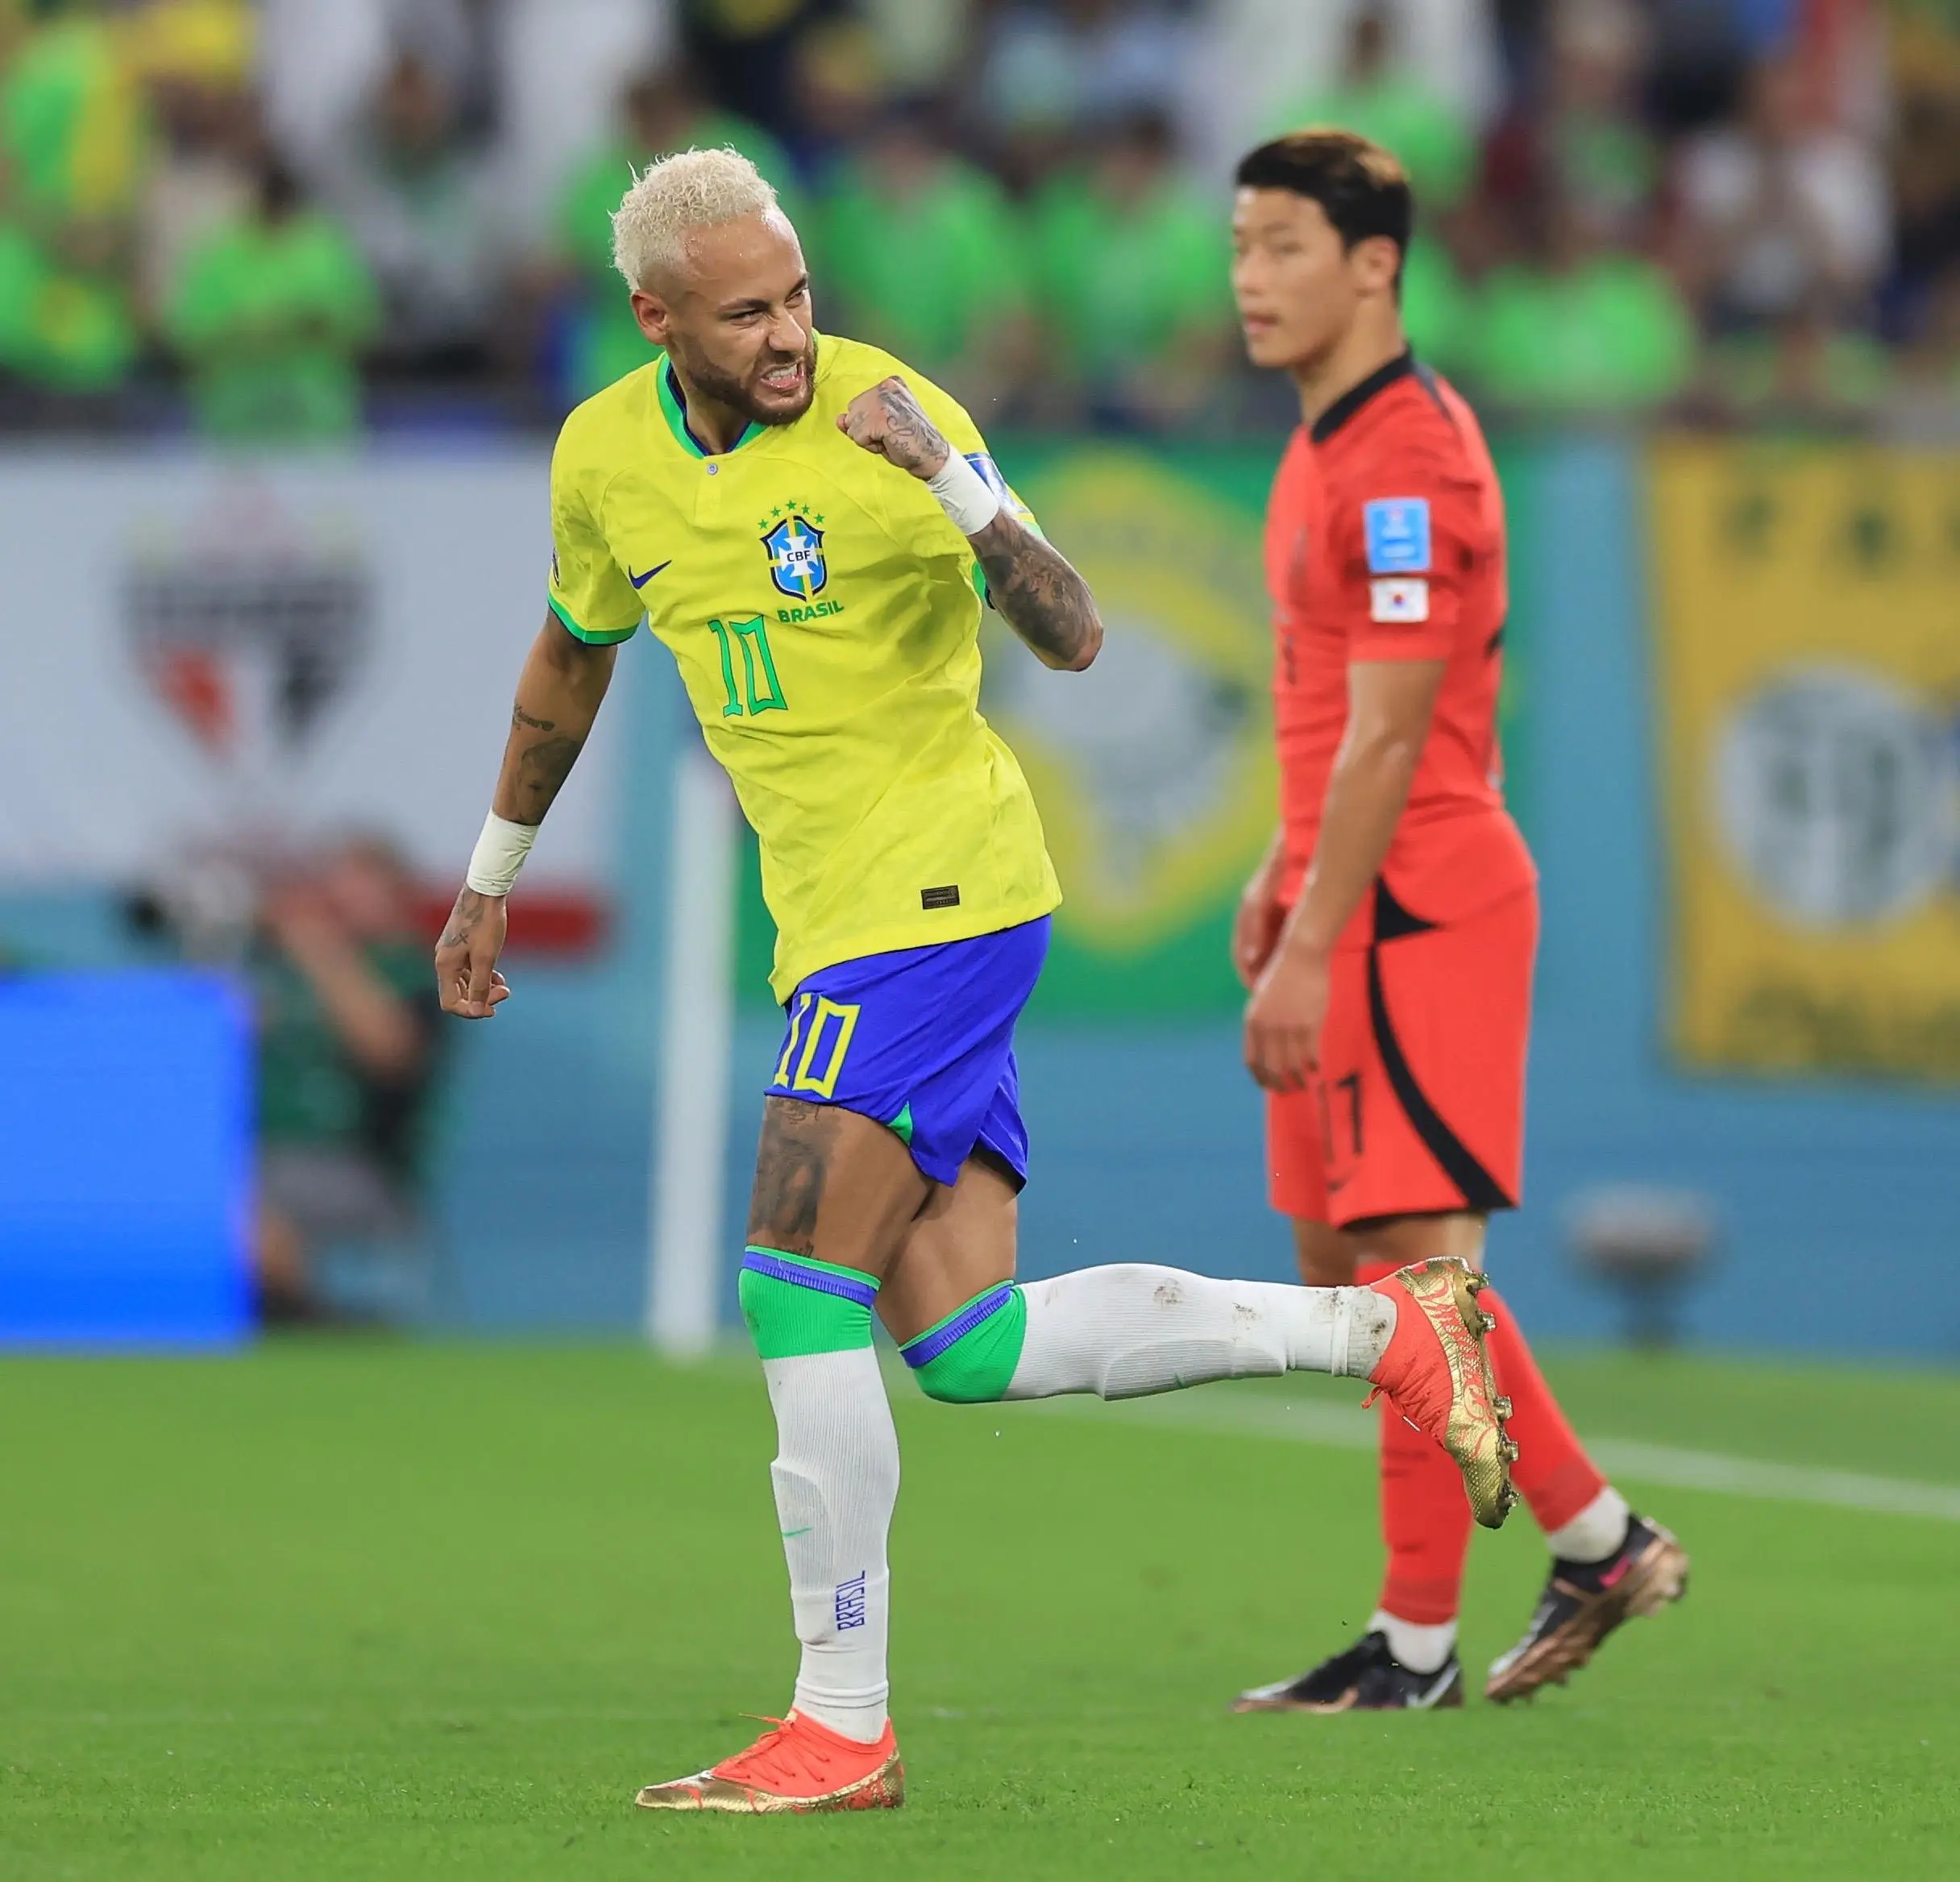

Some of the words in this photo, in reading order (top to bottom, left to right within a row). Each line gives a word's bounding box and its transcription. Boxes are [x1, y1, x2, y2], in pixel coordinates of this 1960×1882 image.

[787, 550, 812, 563] CBF
[777, 600, 845, 623] BRASIL
[707, 613, 789, 718] 10
[774, 992, 861, 1099] 10
[836, 1569, 865, 1630] BRASIL
